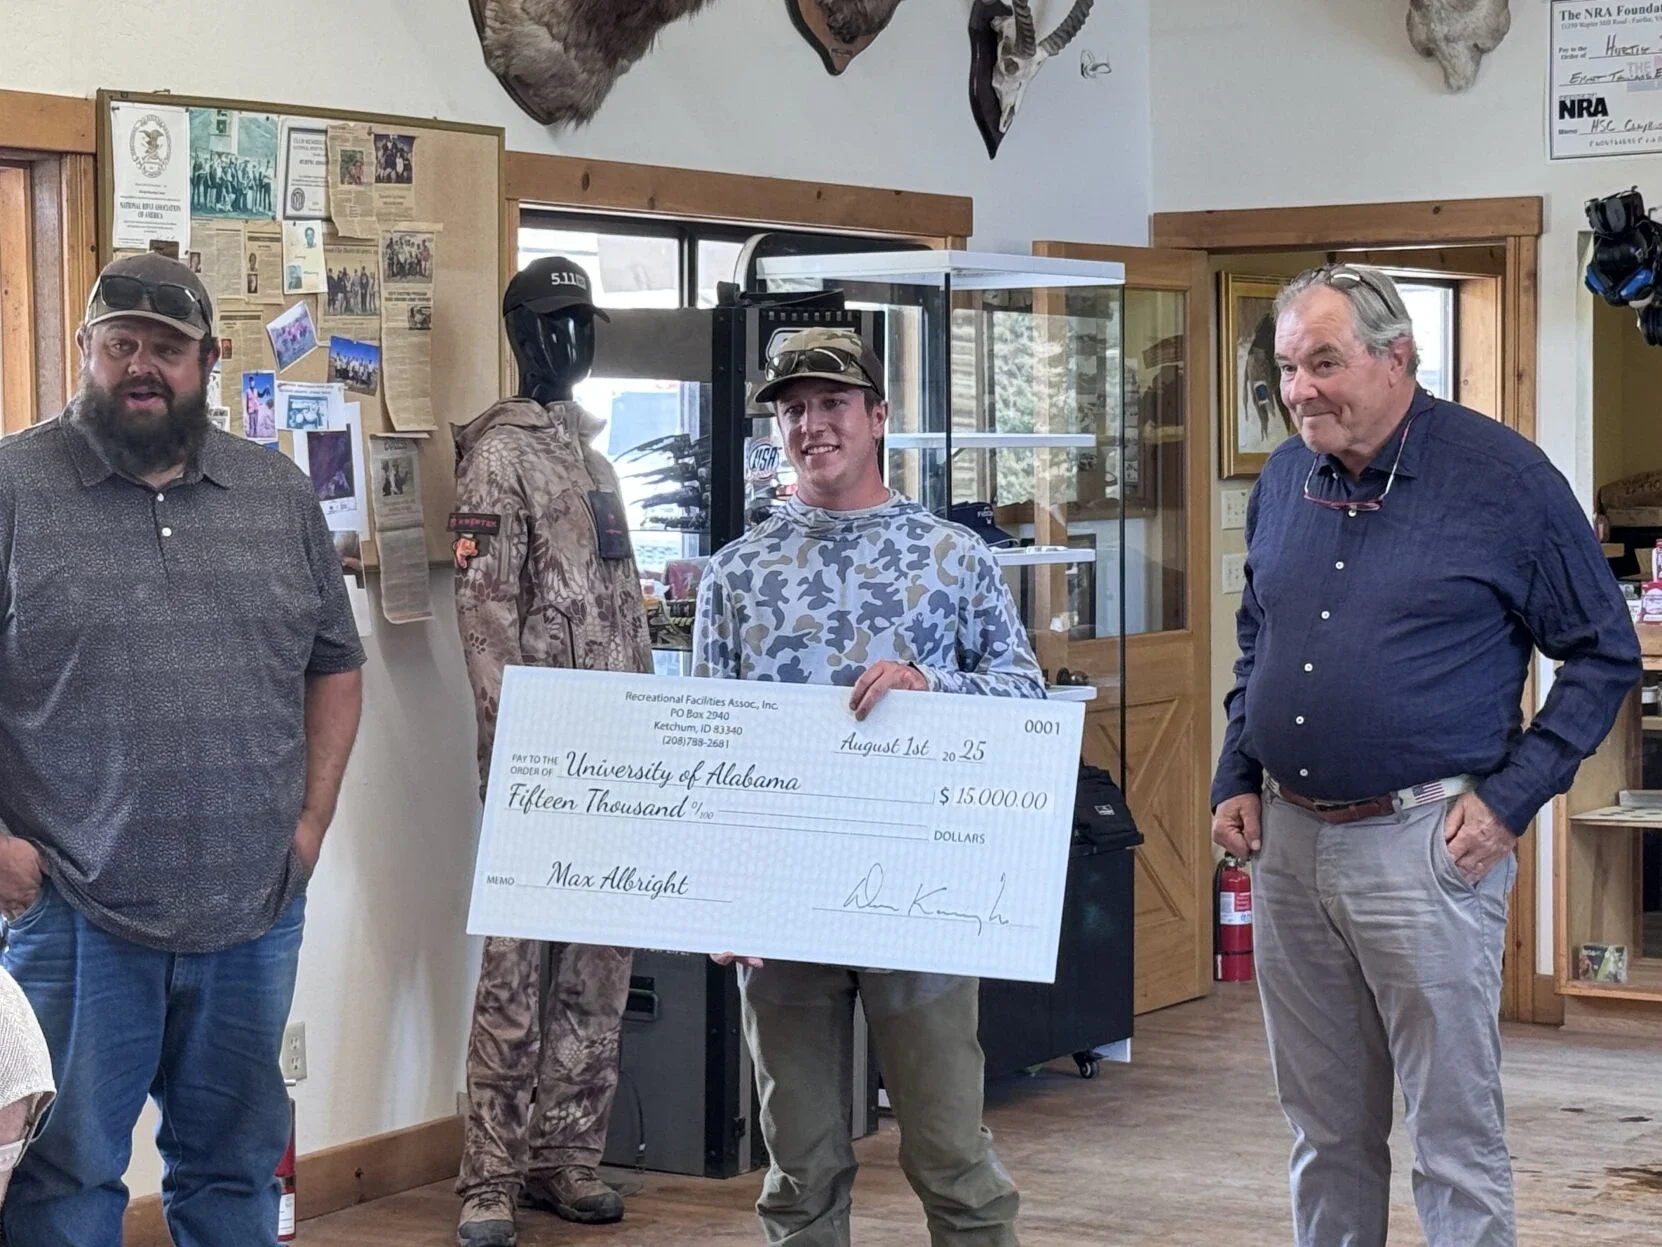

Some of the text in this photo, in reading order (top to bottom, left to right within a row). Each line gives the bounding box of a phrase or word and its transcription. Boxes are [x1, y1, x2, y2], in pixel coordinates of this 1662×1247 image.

[1559, 10, 1581, 21] The
[1584, 7, 1612, 19] NRA
[1558, 97, 1609, 120] NRA
[625, 691, 684, 704] Recreational
[686, 695, 726, 707] Facilities
[762, 700, 778, 710] Inc.
[670, 708, 730, 721] PO Box 2940
[654, 721, 743, 736] Ketchum, ID 83340
[1024, 719, 1061, 735] 0001
[840, 732, 987, 762] August 1st 20 25
[512, 754, 559, 766] PAY TO THE
[510, 765, 553, 777] ORDER OF
[566, 750, 801, 790] University of Alabama
[508, 783, 579, 814] Fifteen
[586, 788, 689, 818] Thousand
[939, 786, 949, 806] $
[933, 830, 986, 845] DOLLARS
[486, 874, 515, 886] MEMO
[546, 860, 689, 900] Max Albright
